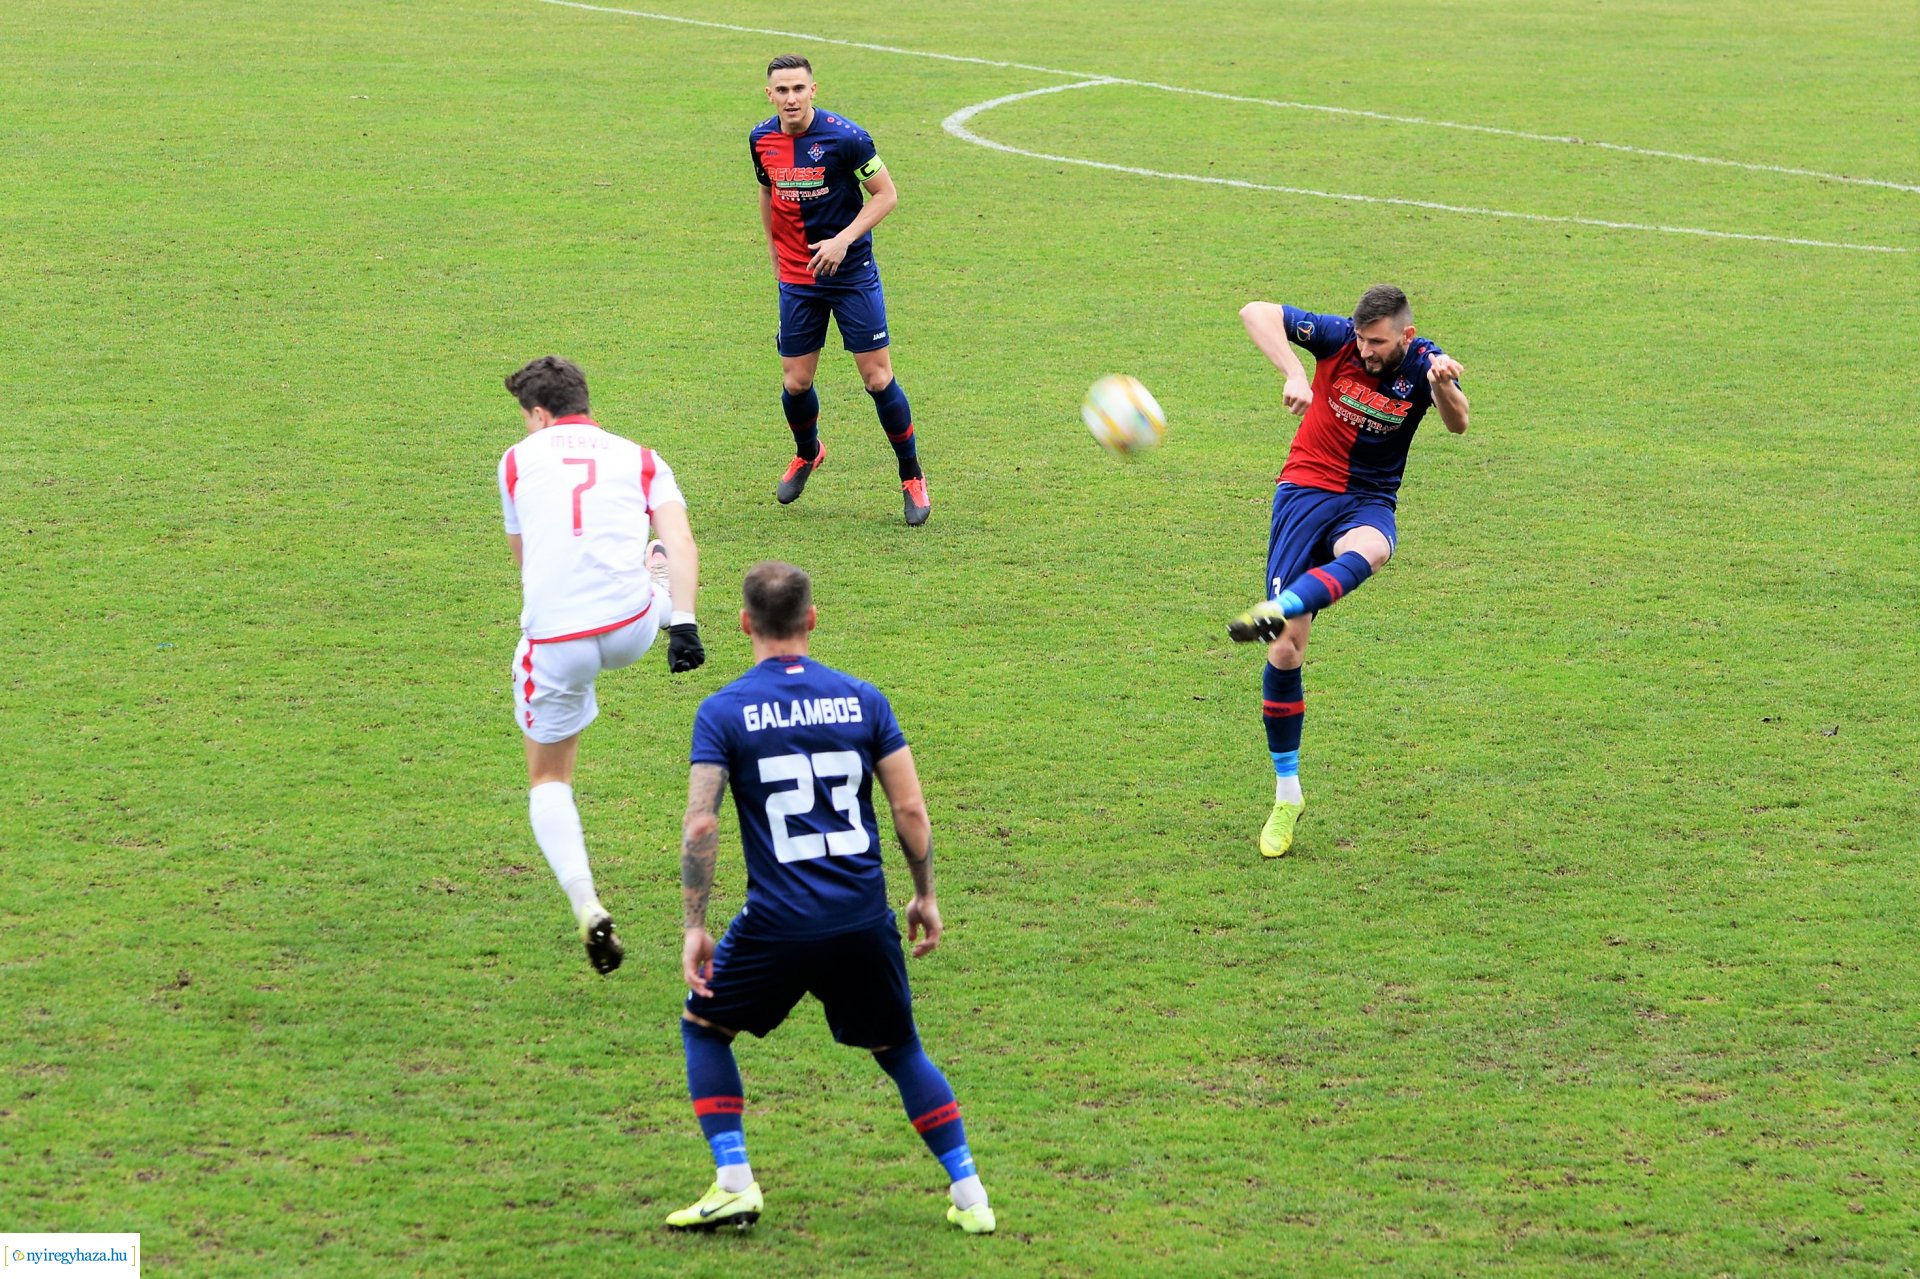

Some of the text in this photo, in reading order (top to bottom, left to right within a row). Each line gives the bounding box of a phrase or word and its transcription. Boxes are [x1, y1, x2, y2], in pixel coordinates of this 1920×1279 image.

[861, 162, 875, 177] C
[562, 457, 597, 537] 7
[742, 696, 863, 732] GALAMBOS
[757, 750, 871, 864] 23
